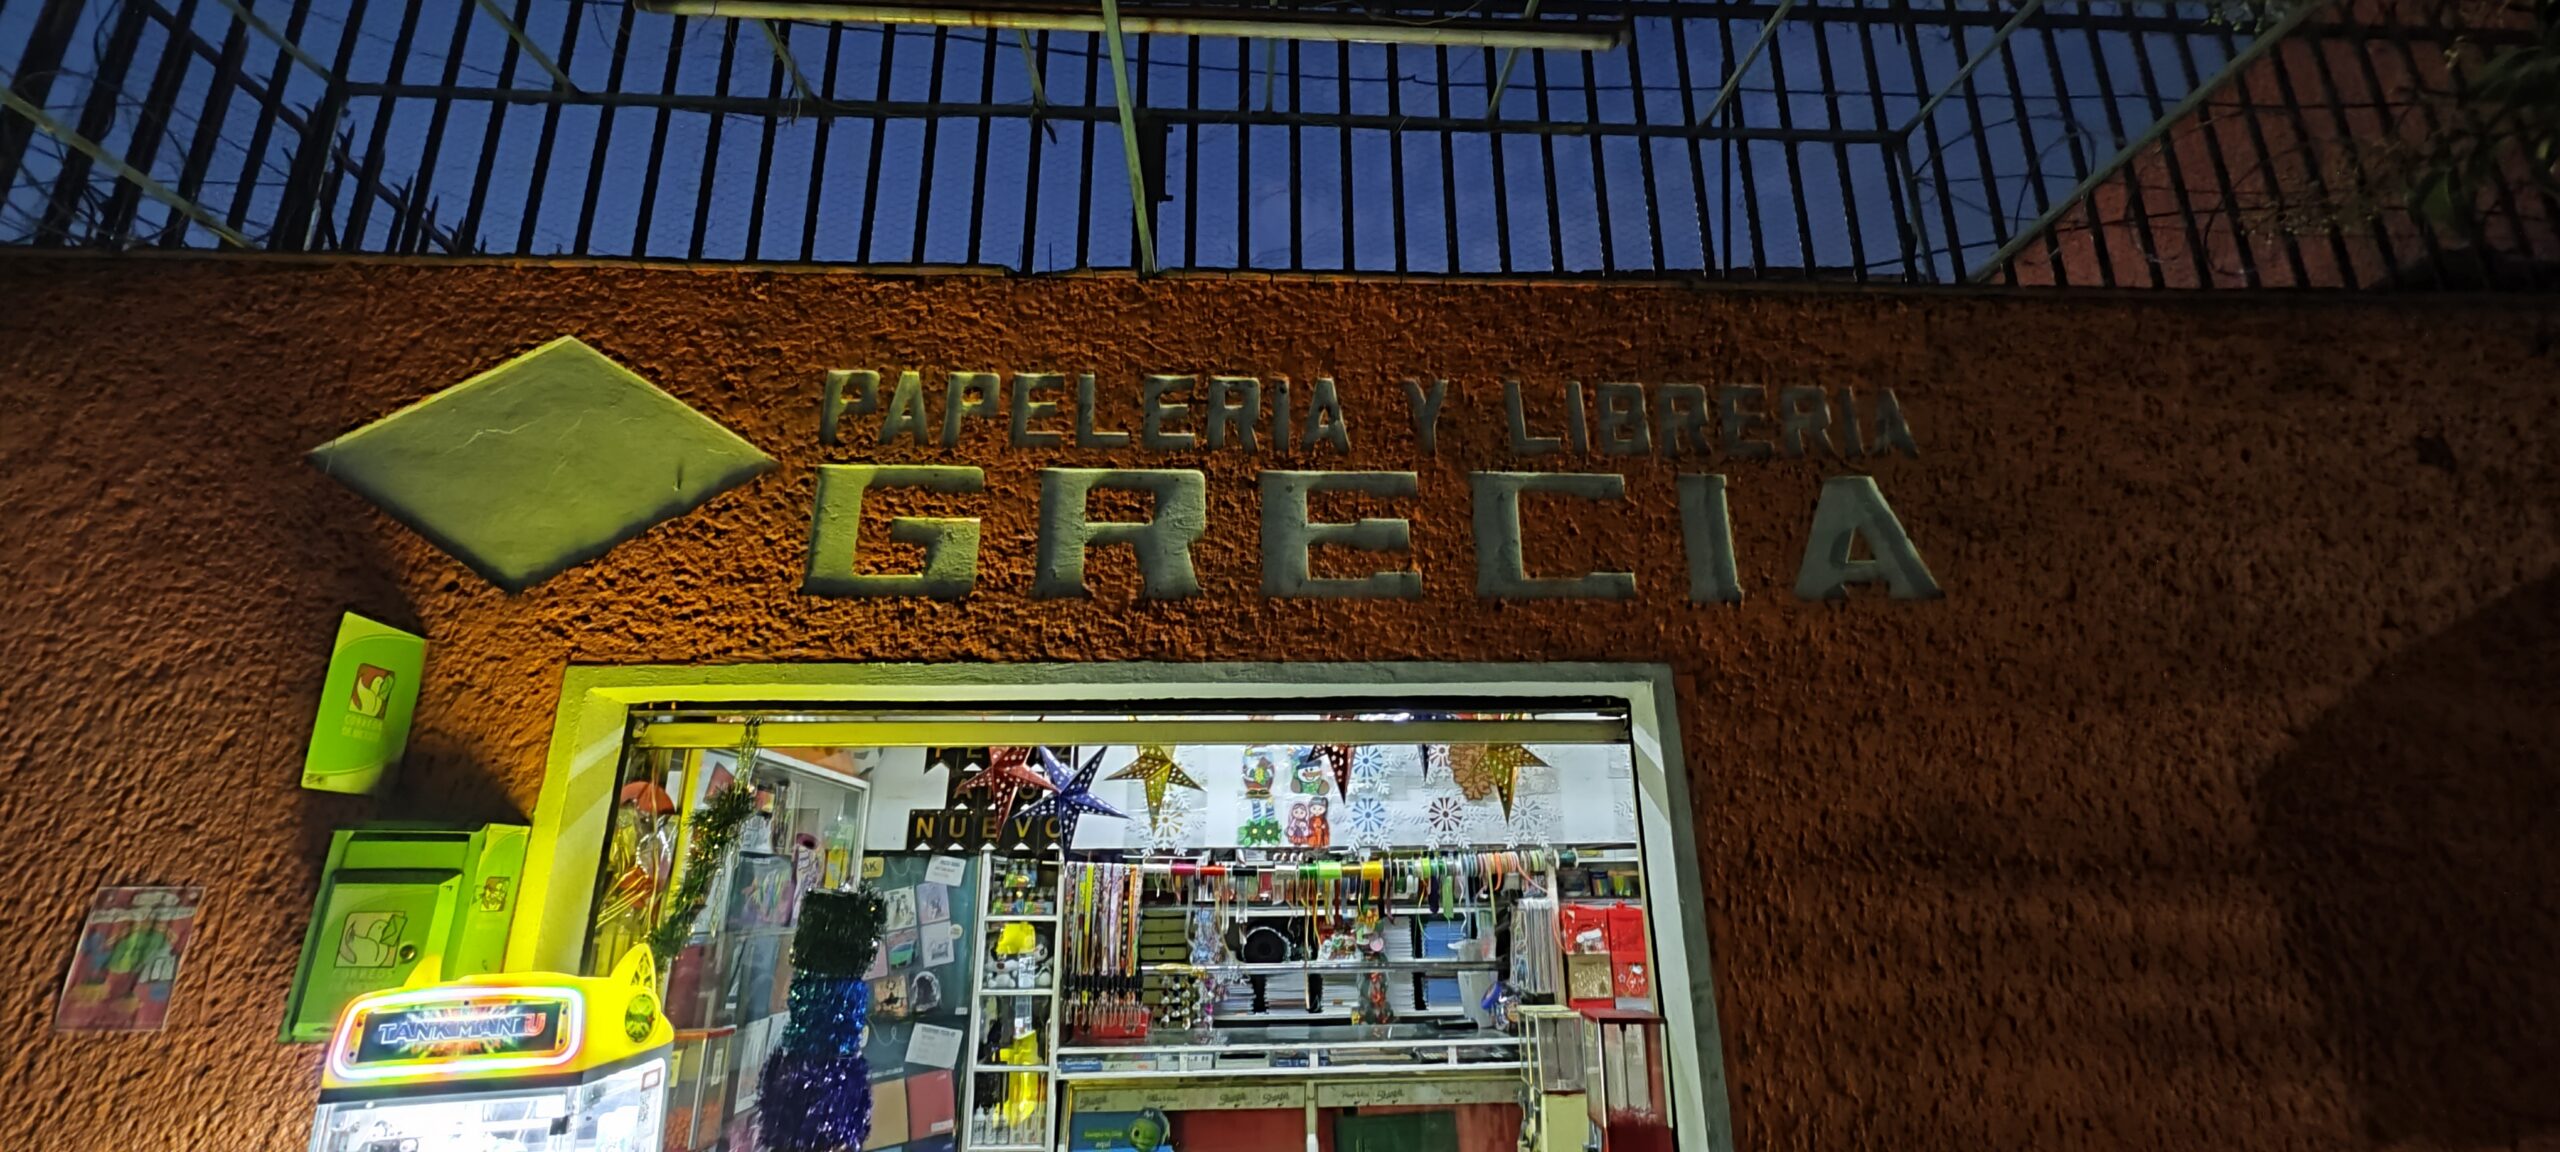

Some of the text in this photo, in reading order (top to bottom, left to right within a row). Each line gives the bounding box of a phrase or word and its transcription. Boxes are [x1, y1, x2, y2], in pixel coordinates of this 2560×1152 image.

[820, 369, 1921, 459] PAPELERIA Y LIBRERIA
[801, 463, 1946, 607] GRECIA
[915, 815, 1062, 839] NUEVO
